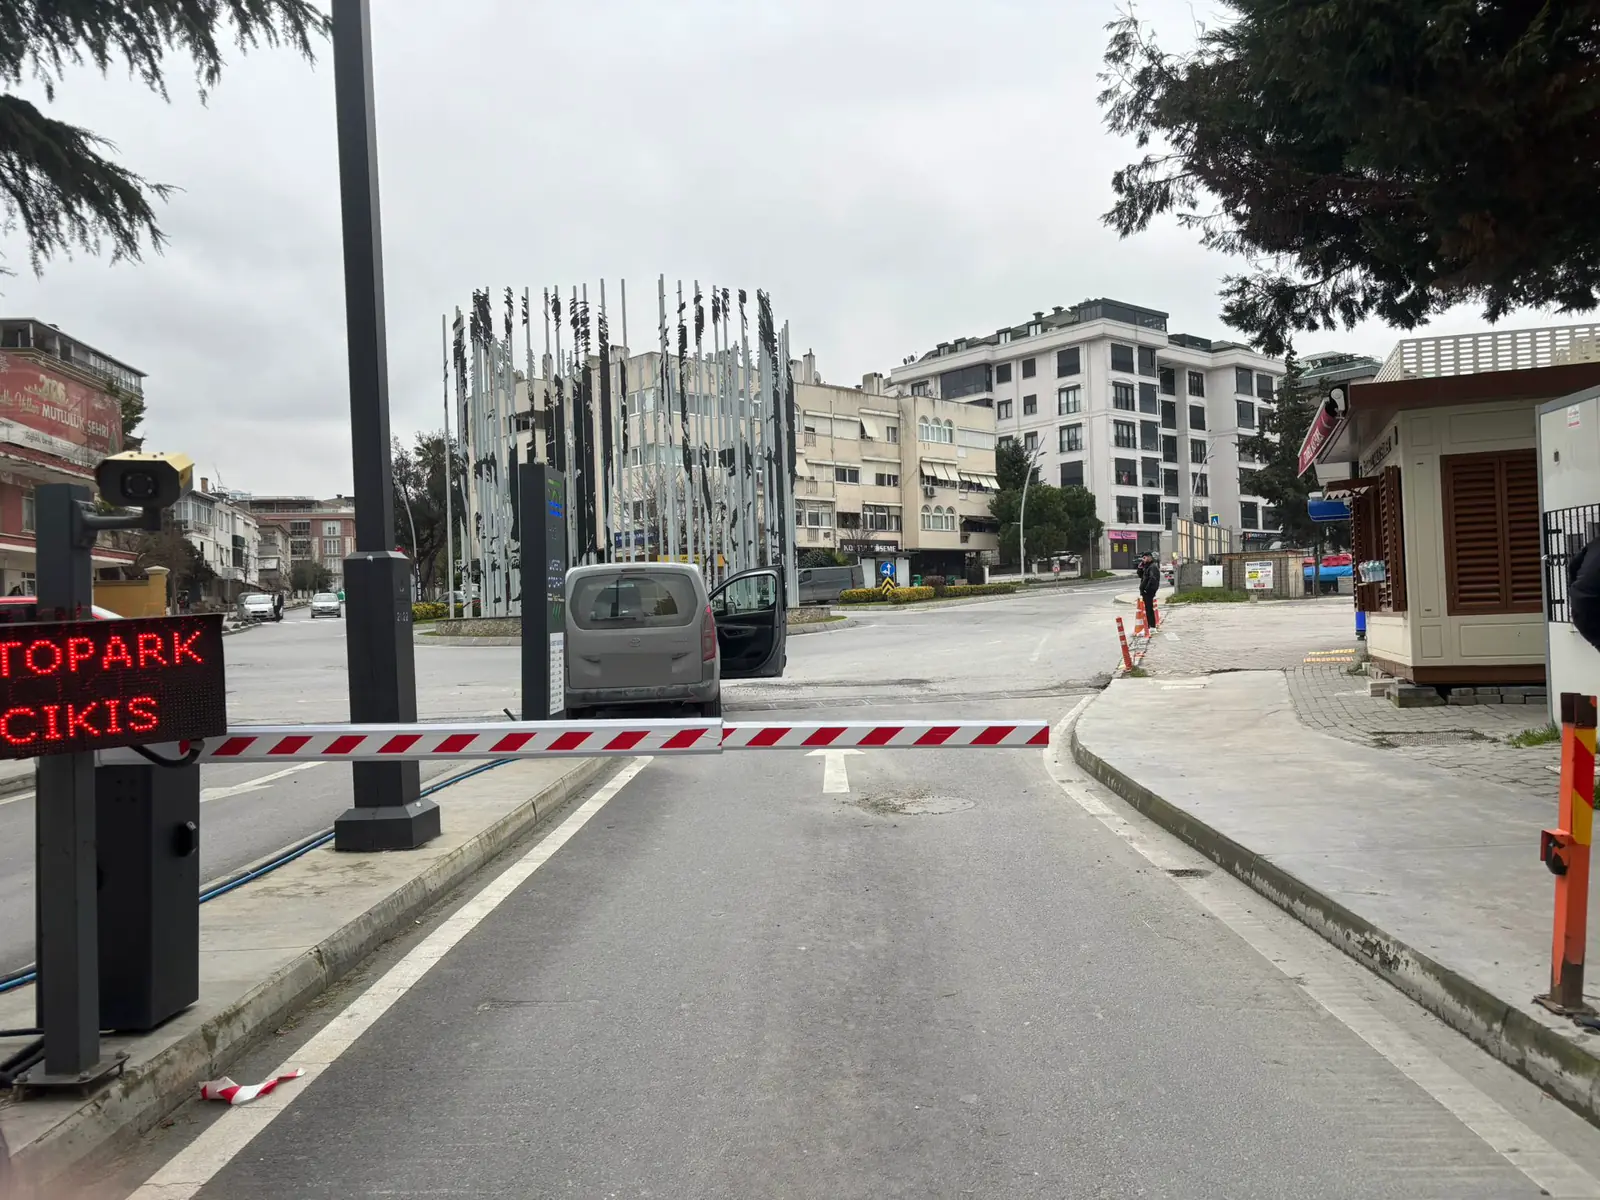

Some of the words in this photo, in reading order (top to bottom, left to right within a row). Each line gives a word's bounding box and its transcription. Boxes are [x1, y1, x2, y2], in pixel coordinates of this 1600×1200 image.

[42, 403, 85, 431] MUTLULUK
[0, 631, 205, 678] TOPARK
[0, 696, 159, 744] CIKIS
